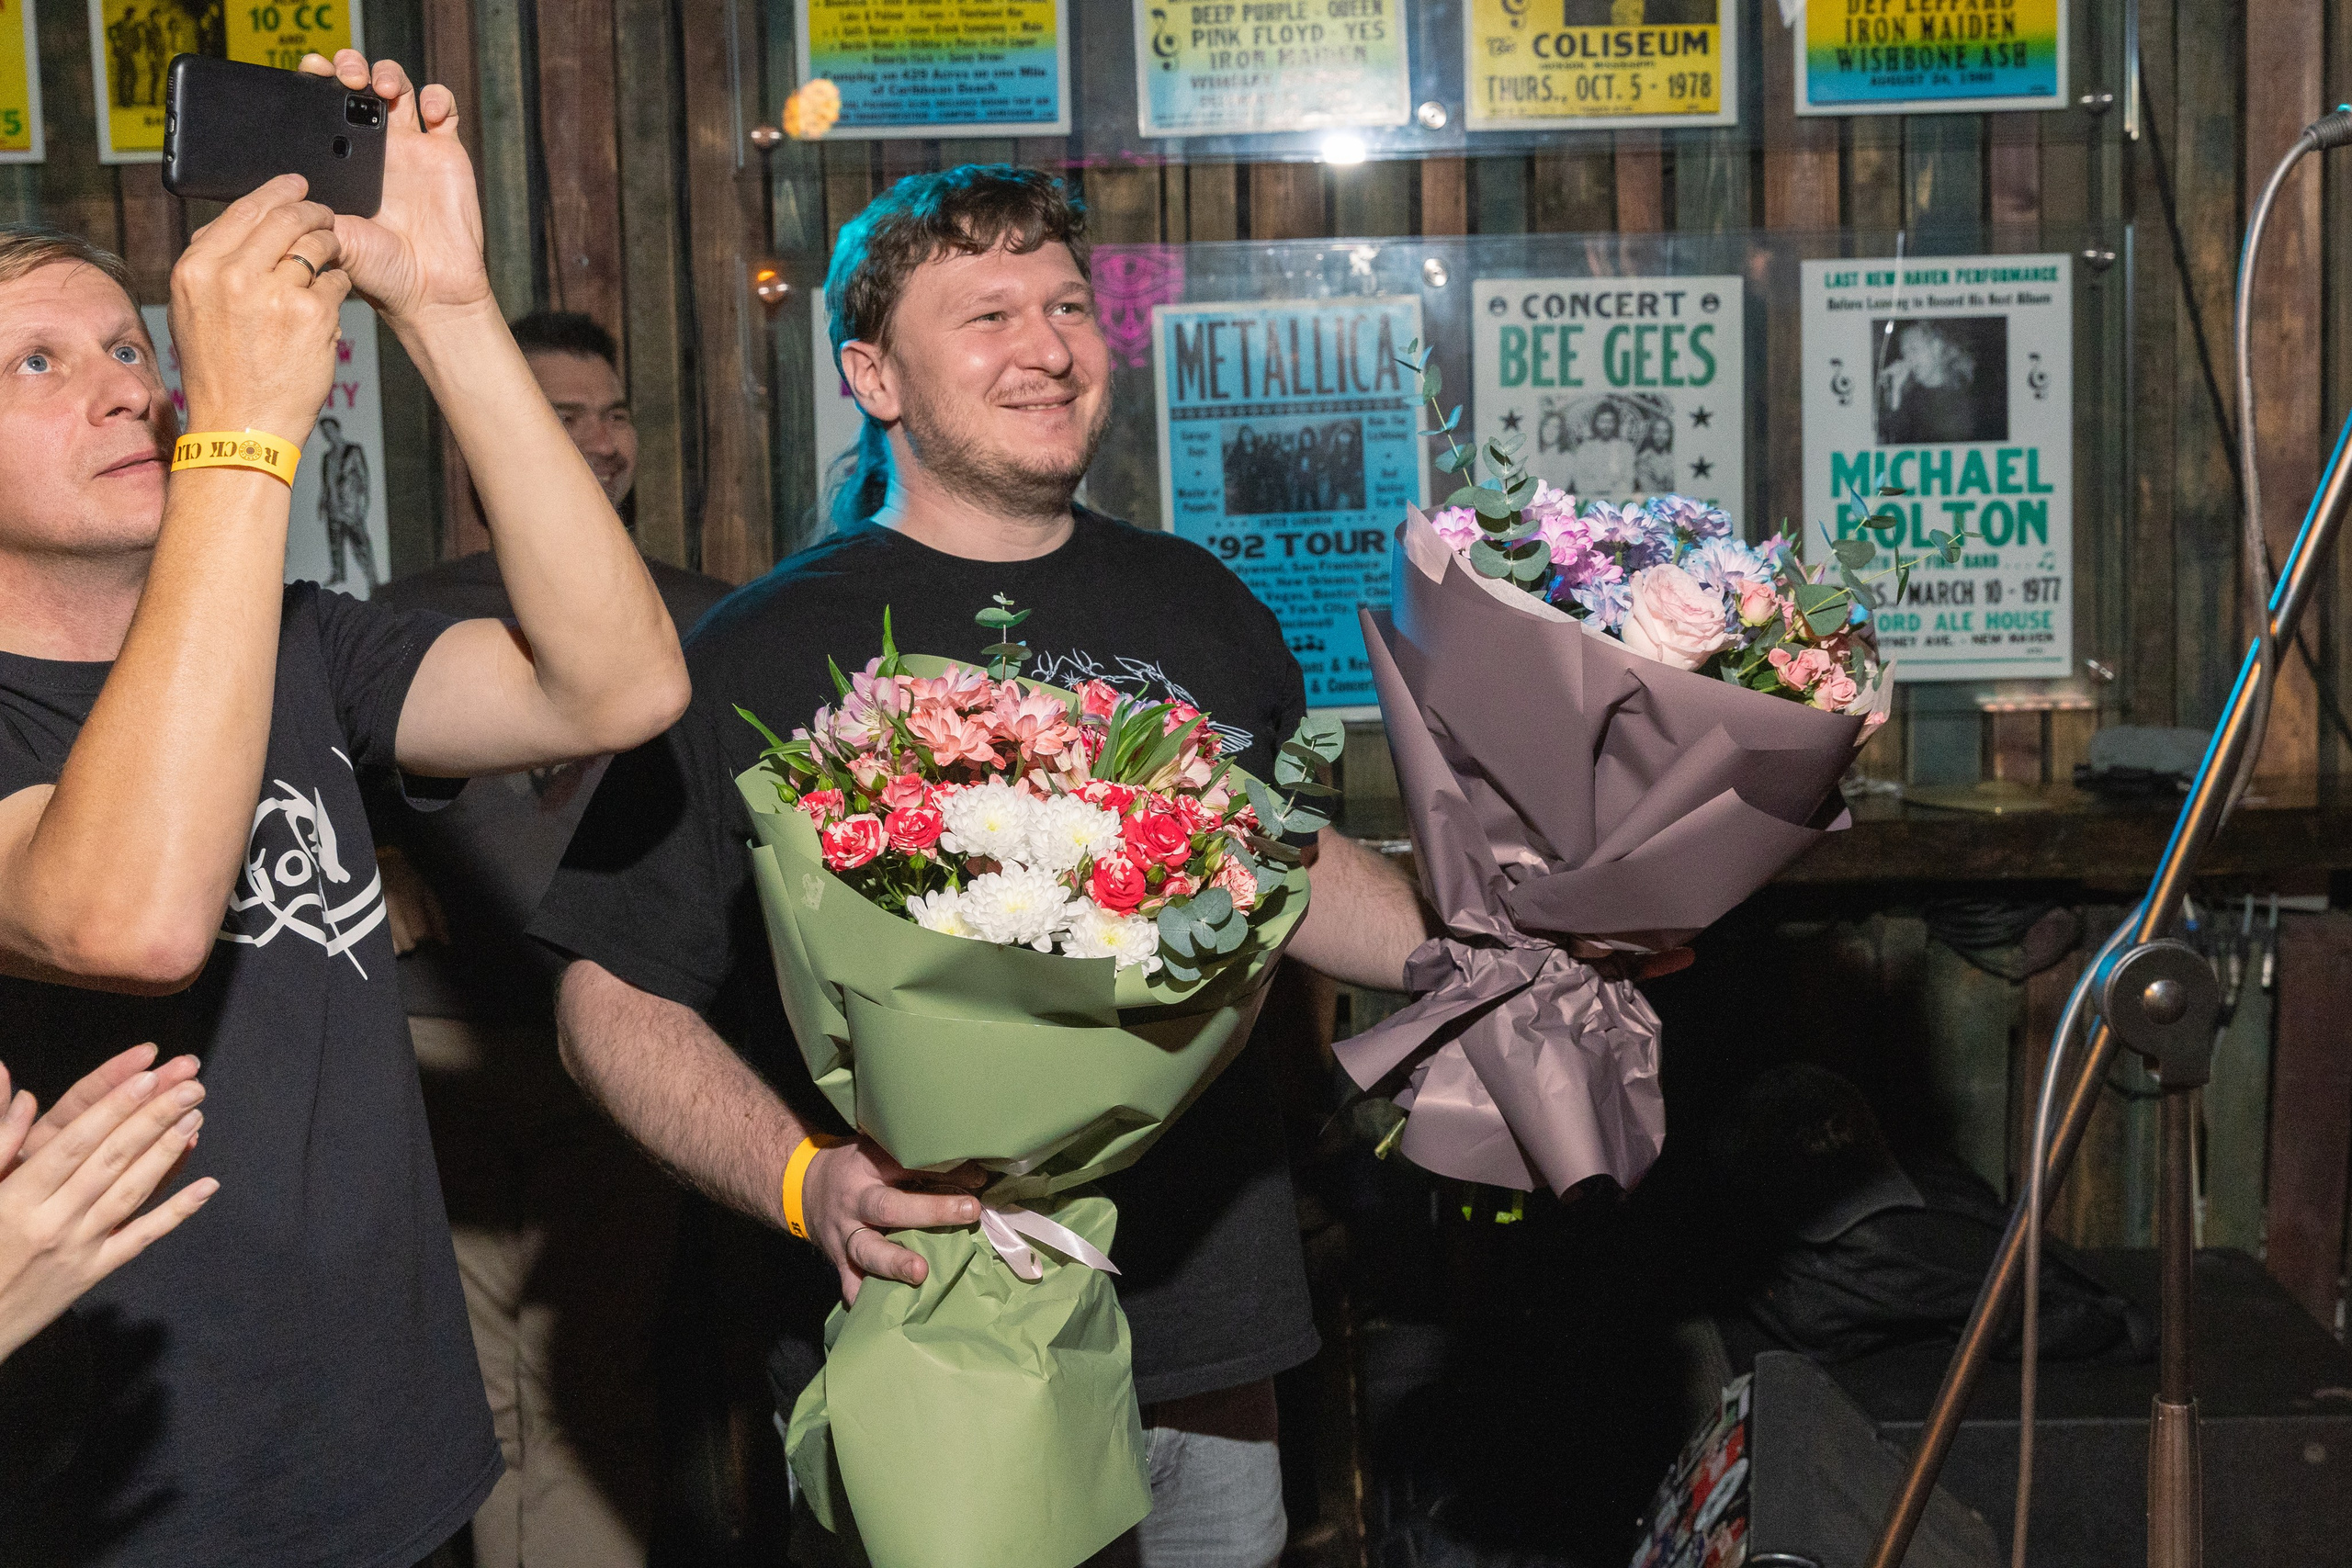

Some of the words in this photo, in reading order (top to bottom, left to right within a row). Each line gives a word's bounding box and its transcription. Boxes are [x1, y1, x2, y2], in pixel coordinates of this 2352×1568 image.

[248, 6, 281, 32] 10
[294, 4, 334, 30] CC
[1191, 6, 1236, 25] DEEP
[1242, 2, 1307, 23] PURPLE
[1191, 29, 1239, 49] PINK
[1253, 25, 1325, 46] FLOYD
[1344, 20, 1385, 40] YES
[1844, 17, 1907, 45] IRON
[1920, 12, 2017, 42] MAIDEN
[1532, 30, 1710, 58] COLISEUM
[1835, 43, 1967, 73] WISHBONE
[1981, 41, 2028, 69] ASH
[1209, 51, 1266, 70] IRON
[1576, 73, 1623, 101] OCT.
[1630, 72, 1642, 100] 5
[1667, 72, 1713, 100] 1978
[1955, 265, 2058, 284] PERFORMANCE
[1521, 291, 1687, 320] CONCERT
[1173, 312, 1401, 401] METALLICA
[1498, 323, 1586, 389] BEE
[1602, 322, 1717, 389] GEES
[173, 443, 202, 464] CLU
[1830, 448, 2054, 497] MICHAEL
[1837, 500, 2049, 548] BOLTON
[1206, 534, 1265, 559] '92
[1273, 529, 1386, 558] TOUR
[1907, 580, 1975, 606] MARCH
[2021, 576, 2062, 603] 1977
[1876, 612, 1922, 633] ORD
[1934, 611, 1973, 632] ALE
[1985, 610, 2054, 631] HOUSE
